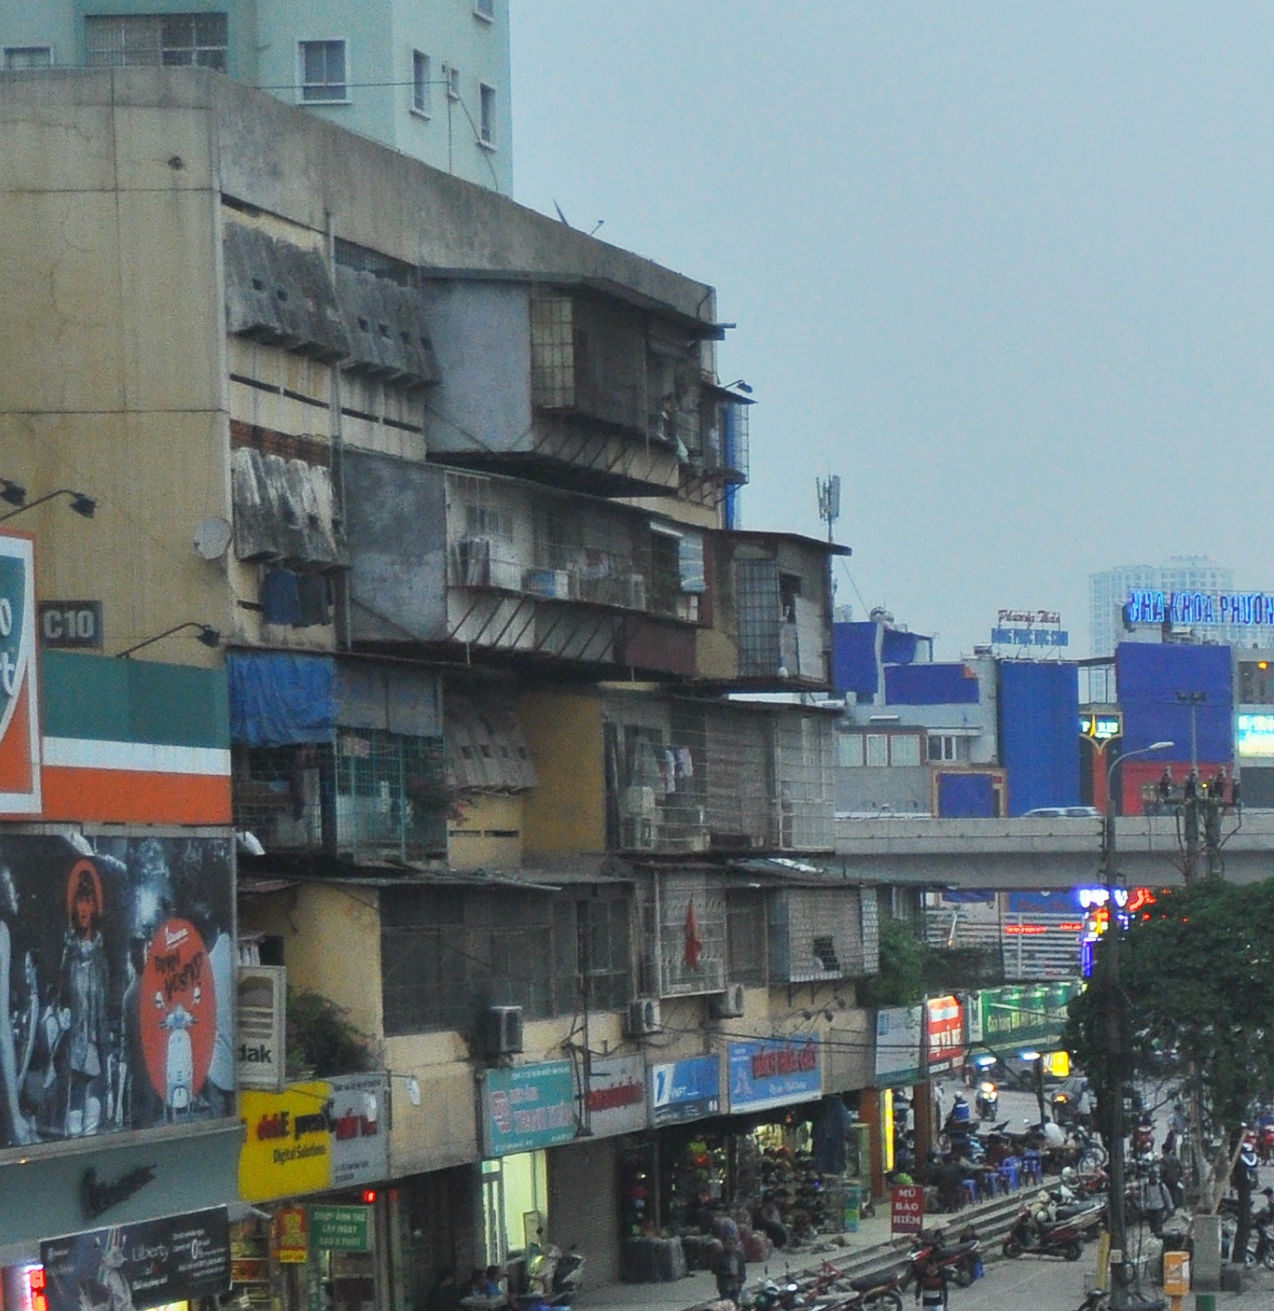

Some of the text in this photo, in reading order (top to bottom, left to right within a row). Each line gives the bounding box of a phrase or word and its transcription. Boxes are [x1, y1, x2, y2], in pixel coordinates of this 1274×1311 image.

[1130, 590, 1165, 622] NHA
[1170, 592, 1214, 624] KHOA
[43, 609, 94, 639] C10
[132, 1241, 169, 1262] Liberty
